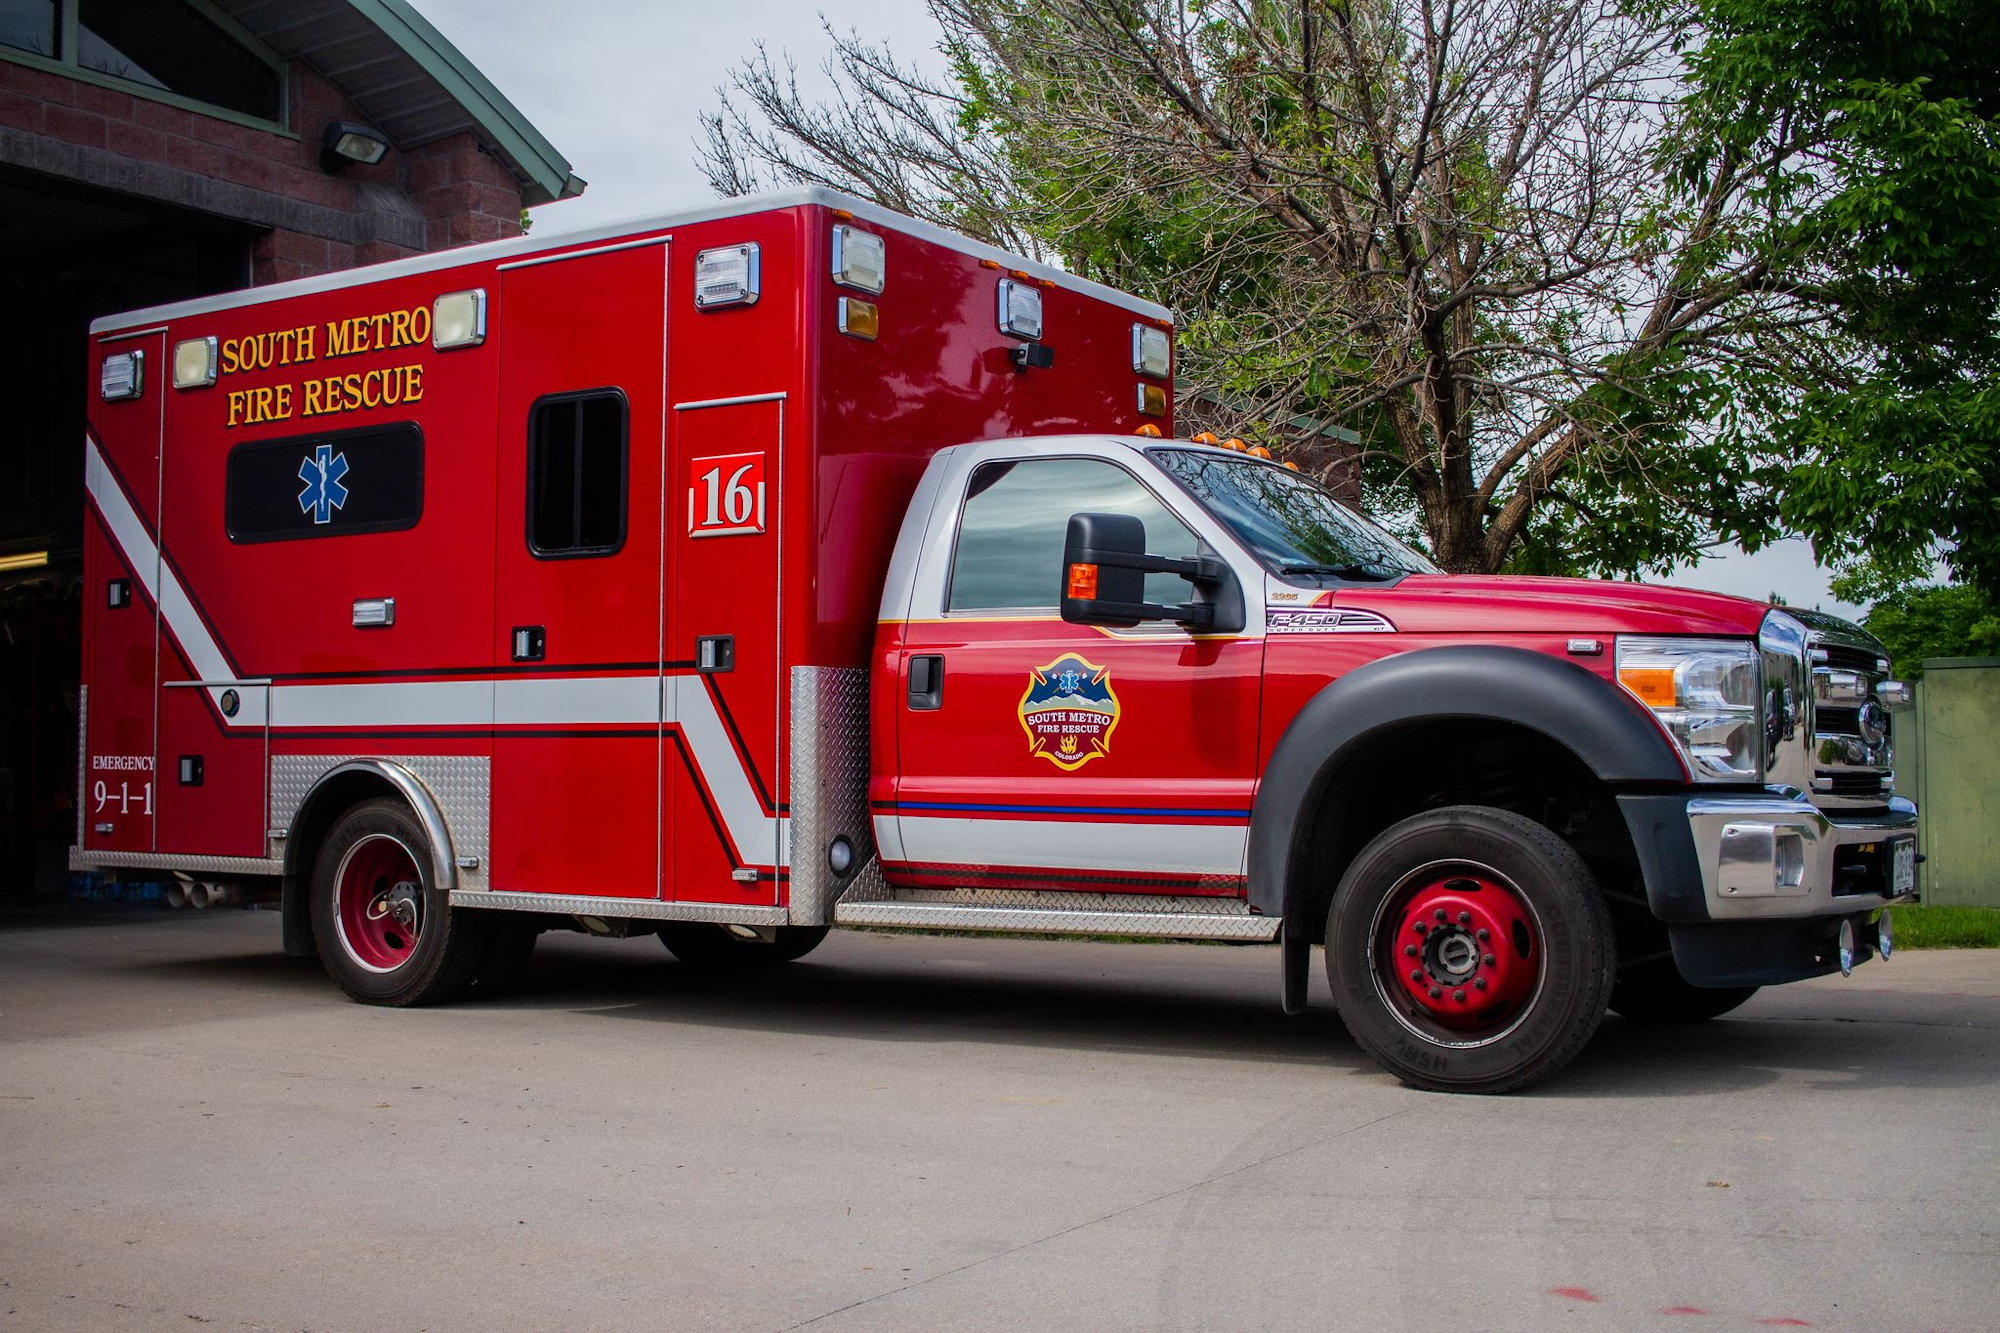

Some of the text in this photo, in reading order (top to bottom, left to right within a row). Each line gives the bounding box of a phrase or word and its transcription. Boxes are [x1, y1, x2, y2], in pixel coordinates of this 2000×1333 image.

[222, 306, 432, 375] SOUTH METRO
[226, 364, 425, 428] FIRE RESCUE
[701, 464, 753, 526] 16
[1268, 613, 1343, 628] F-450
[1028, 712, 1111, 726] SOUTH METRO
[1037, 724, 1100, 734] FIRE RESCUE
[93, 755, 155, 771] EMERGENCY
[1054, 750, 1084, 761] COLORADO
[94, 780, 153, 815] 9-1-1
